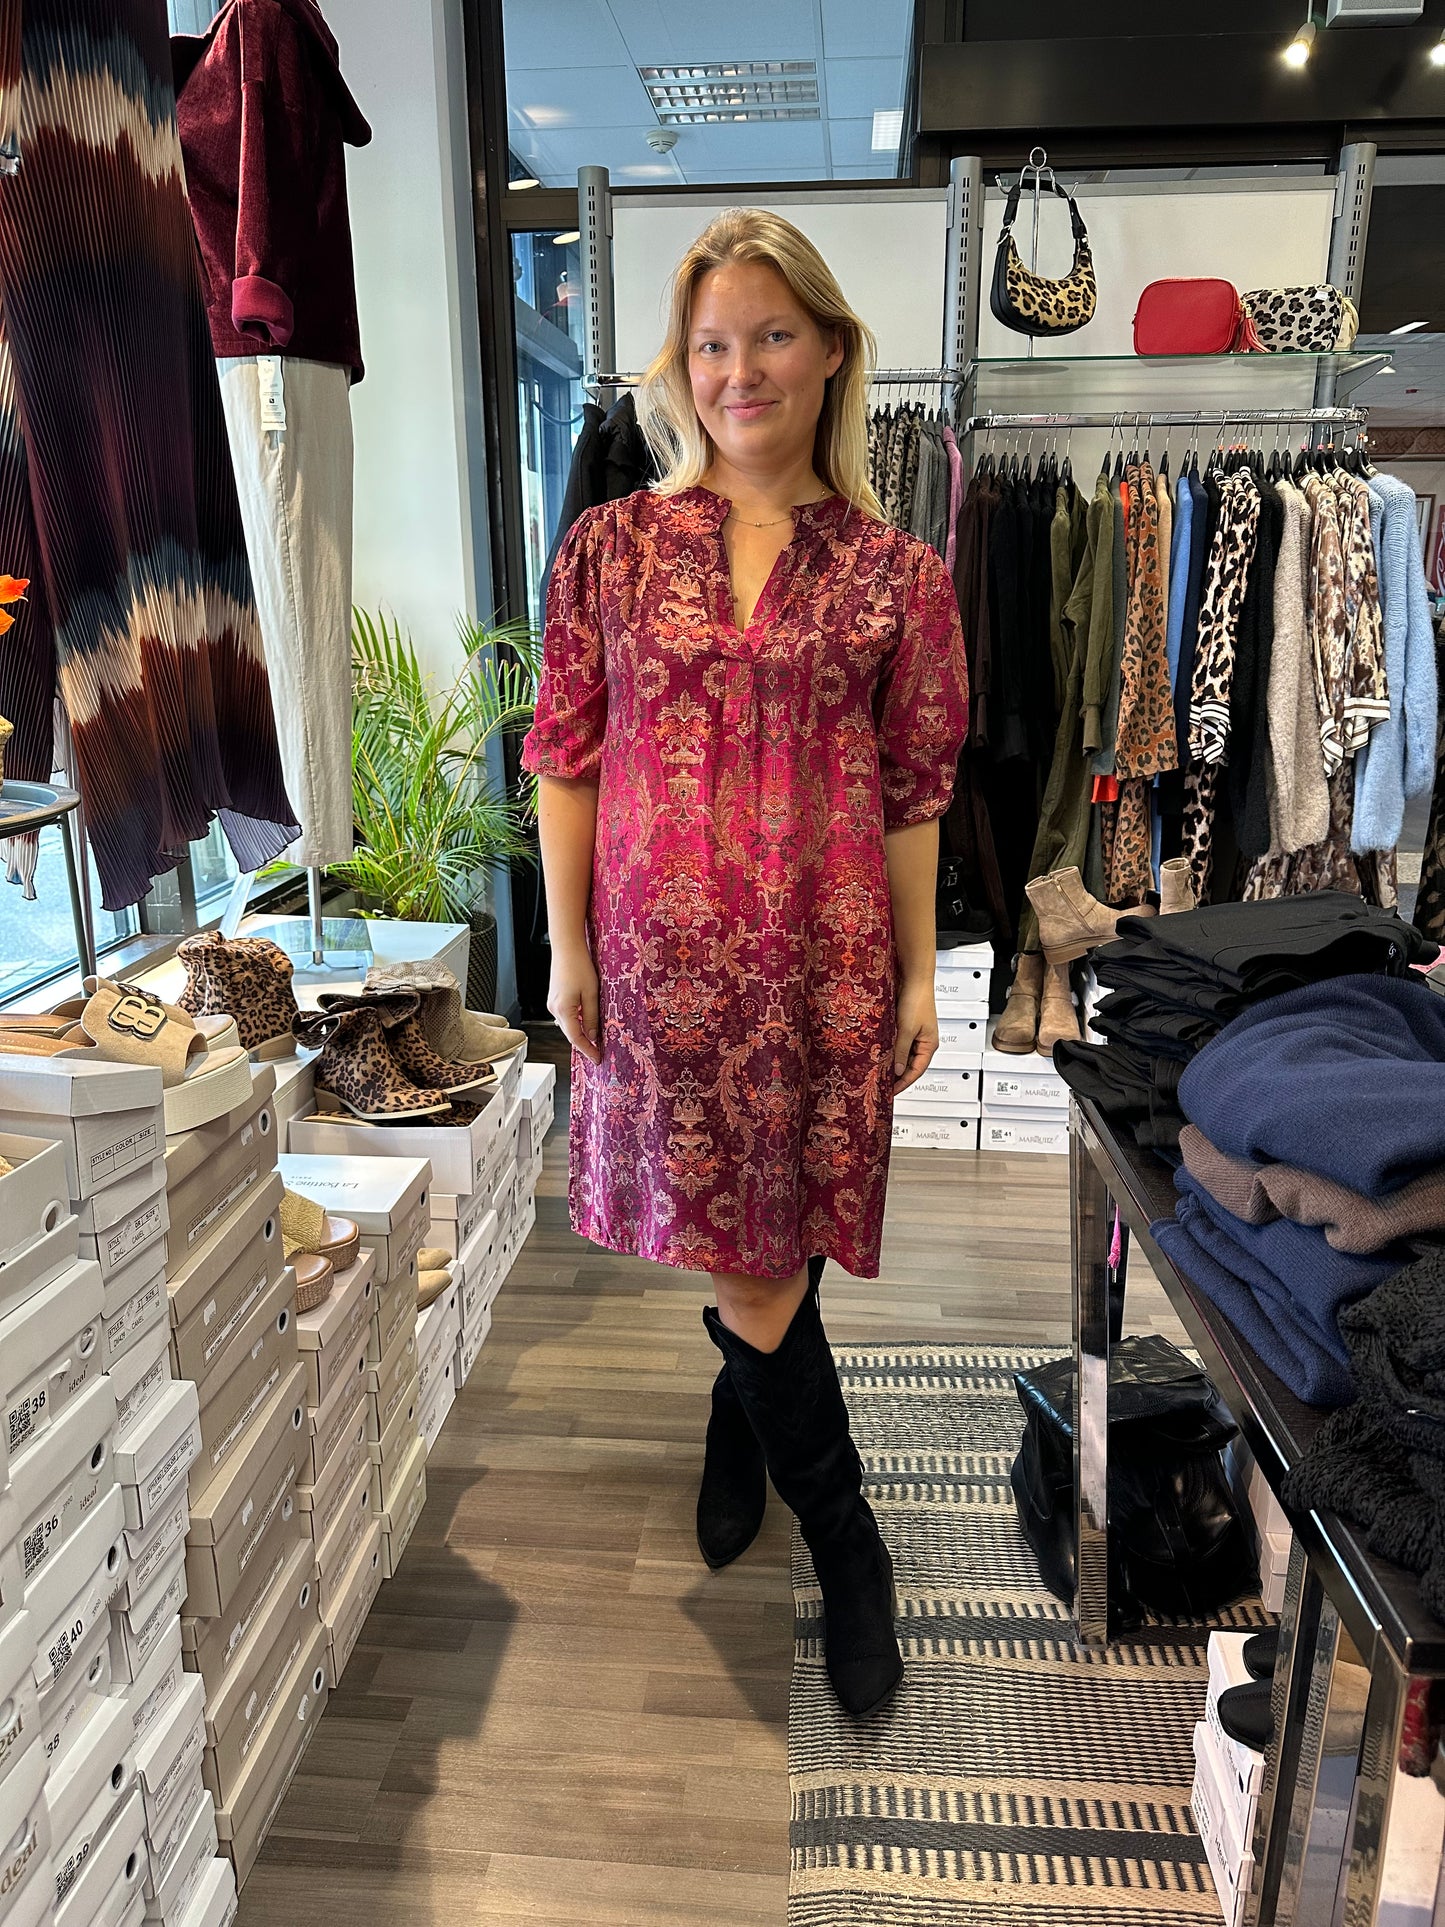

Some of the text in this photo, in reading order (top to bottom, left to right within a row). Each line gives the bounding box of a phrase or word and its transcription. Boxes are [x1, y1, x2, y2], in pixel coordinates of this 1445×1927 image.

[92, 1151, 106, 1164] STYLE
[115, 1138, 133, 1151] COLOR
[139, 1129, 151, 1139] SIZE
[68, 1368, 87, 1394] ideal
[31, 1390, 46, 1415] 38
[79, 1483, 98, 1511] ideal
[44, 1514, 59, 1538] 36
[70, 1618, 83, 1644] 40
[47, 1732, 60, 1759] 38
